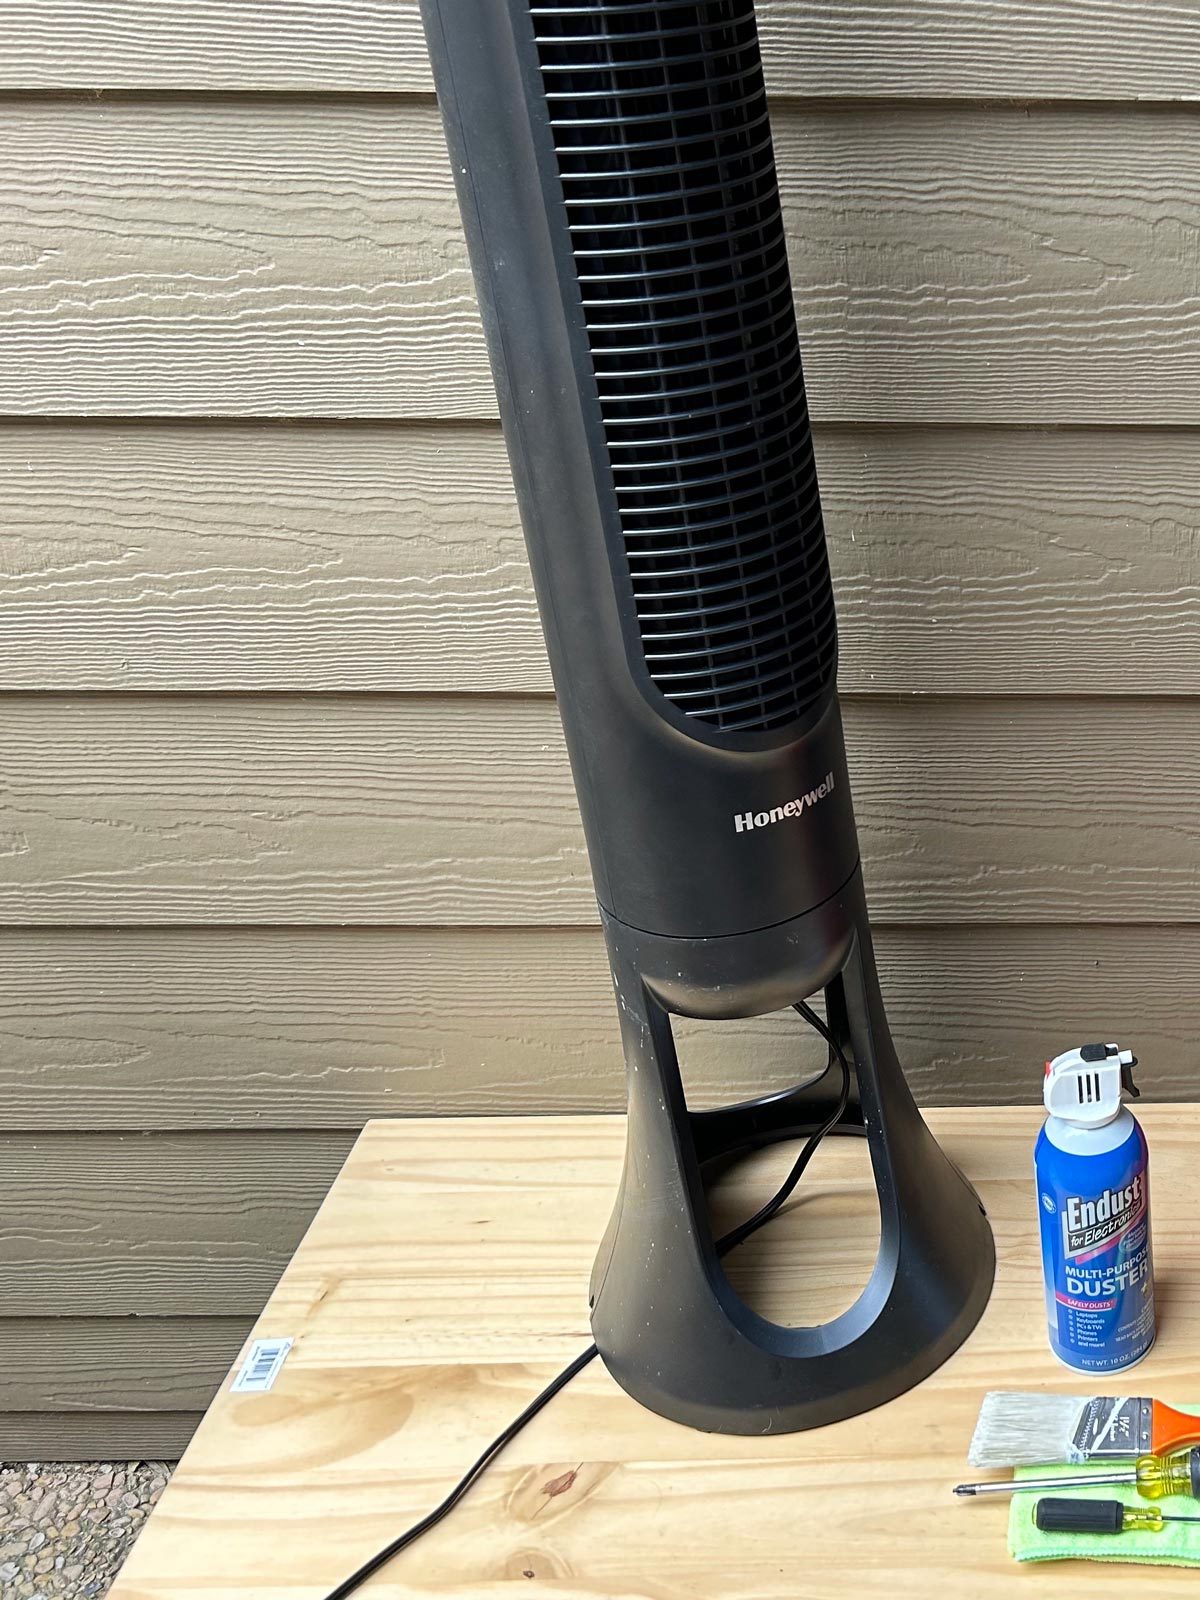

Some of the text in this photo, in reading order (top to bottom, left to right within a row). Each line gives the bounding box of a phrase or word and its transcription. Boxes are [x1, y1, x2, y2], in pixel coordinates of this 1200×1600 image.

[734, 771, 835, 833] Honeywell
[1066, 1176, 1140, 1232] Endust
[1070, 1235, 1084, 1247] for
[1066, 1258, 1148, 1297] DUSTER
[1067, 1299, 1089, 1308] SAFELY
